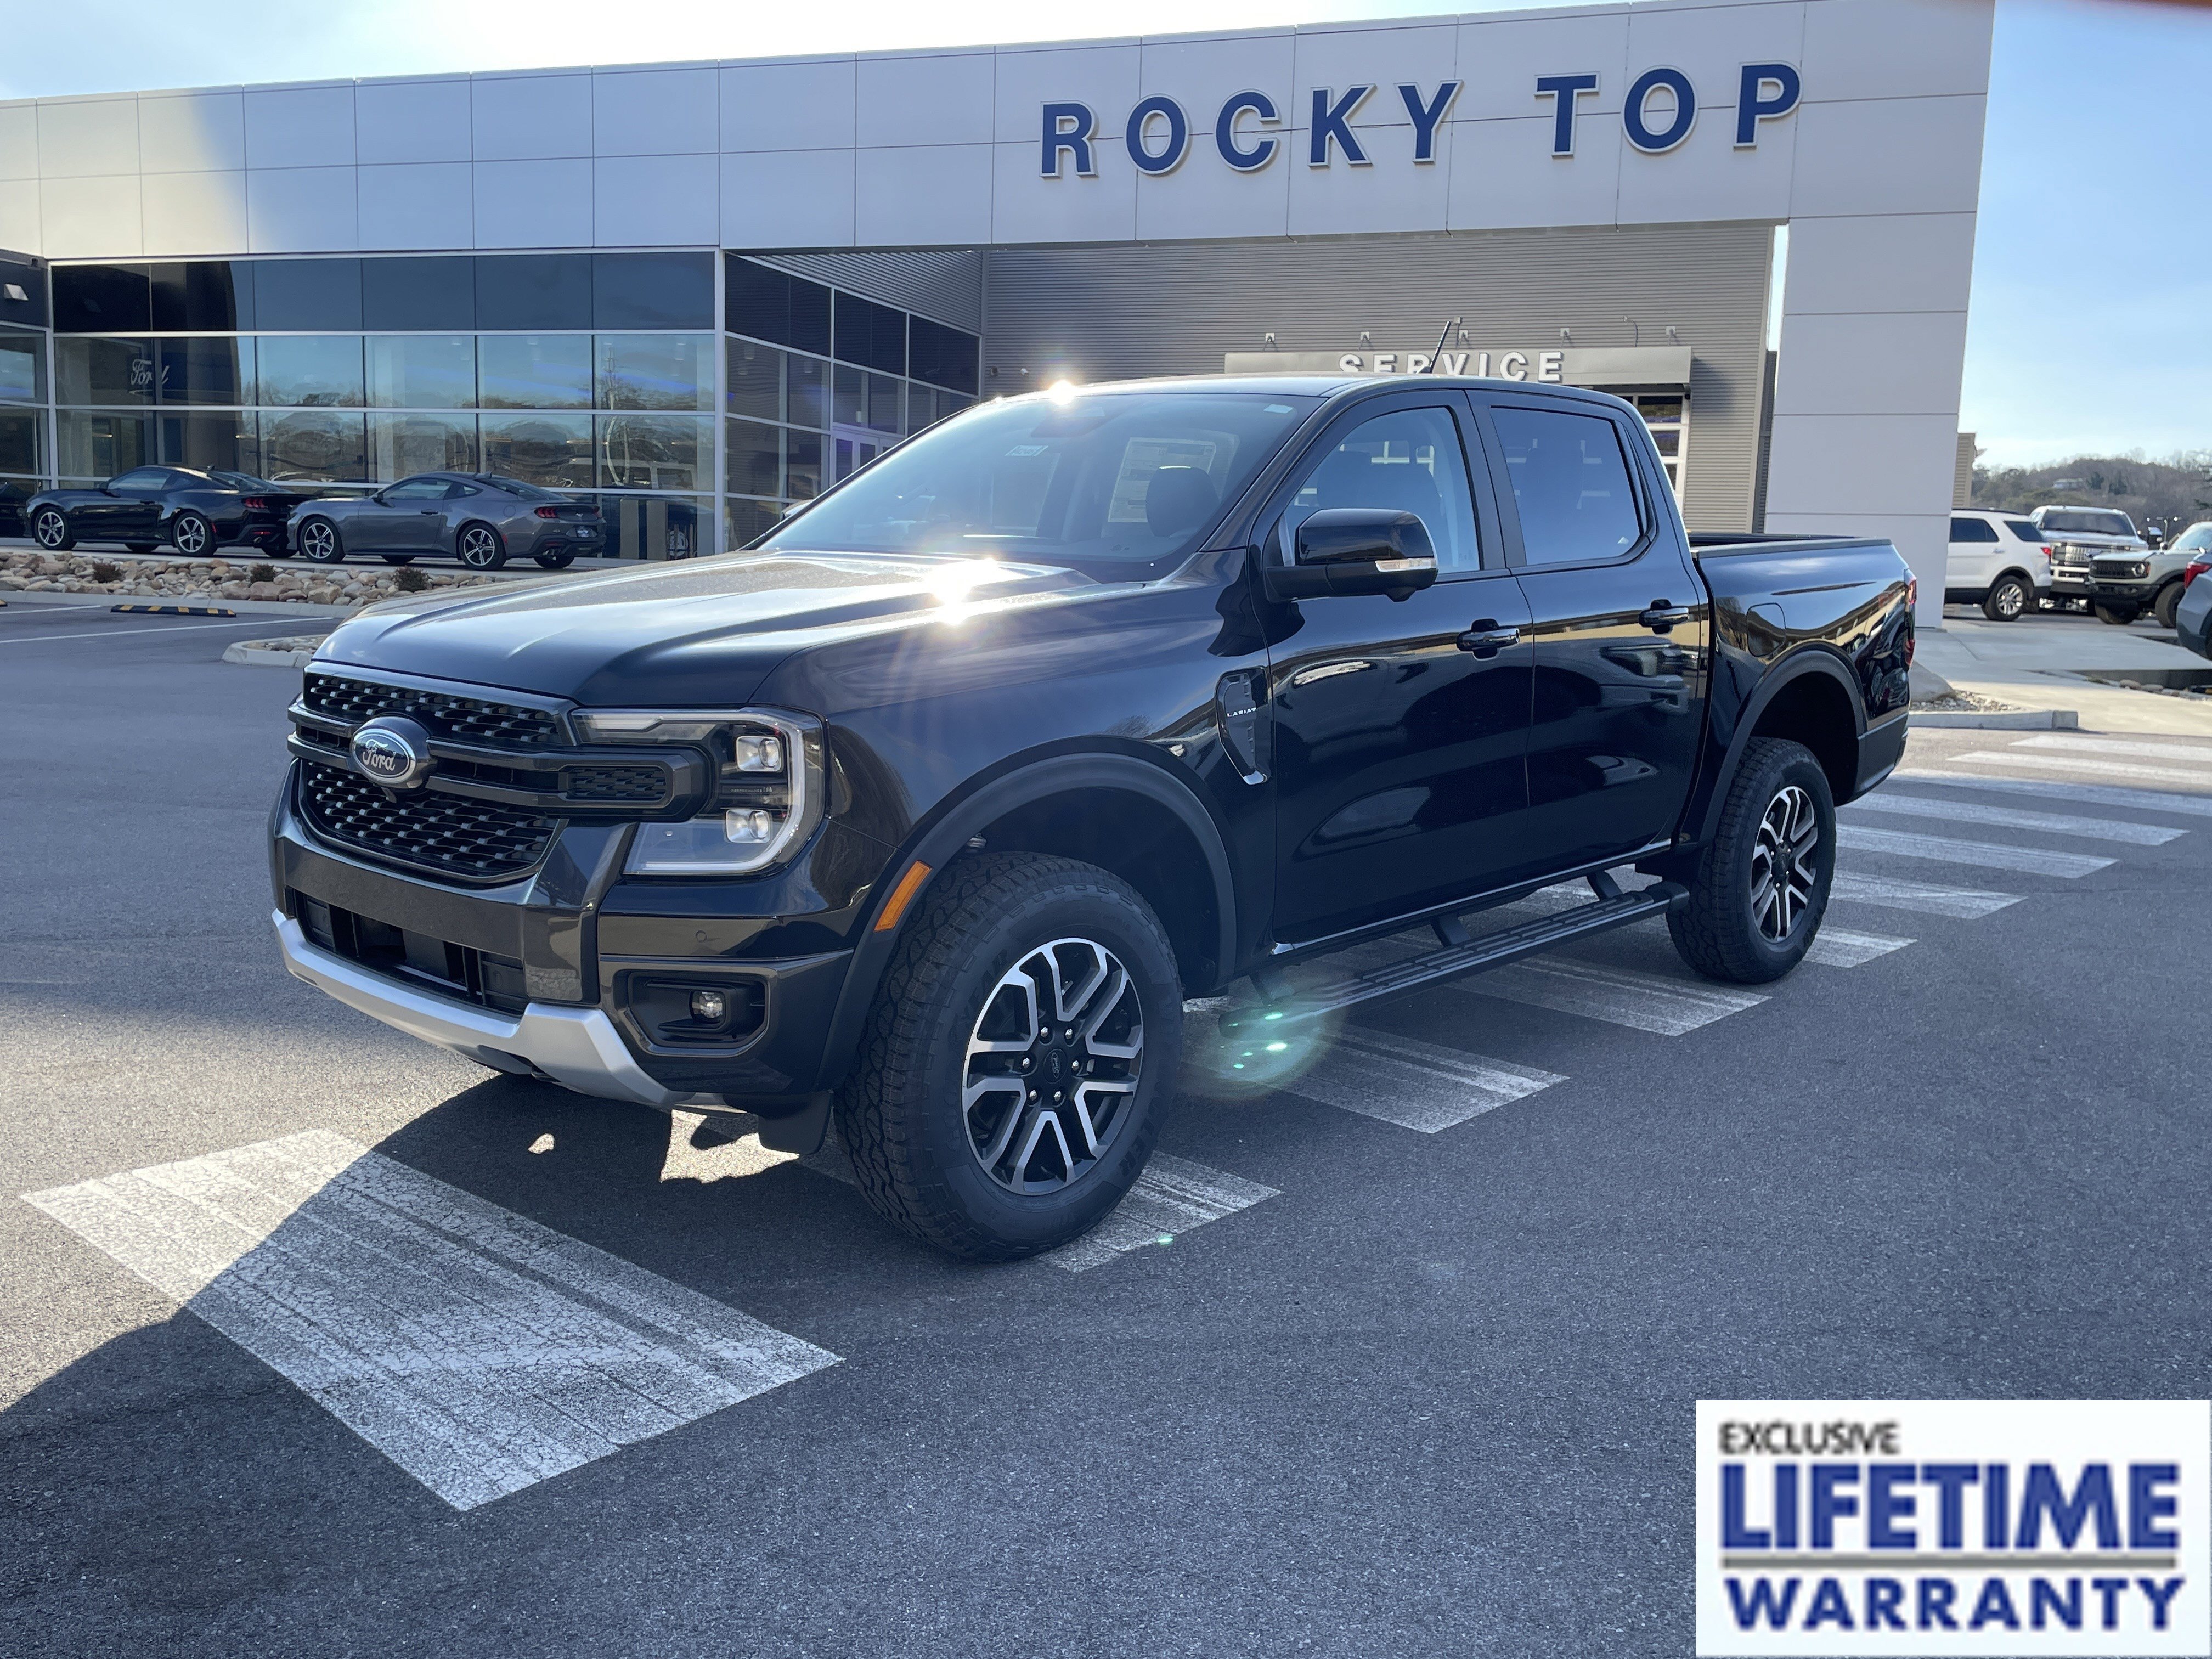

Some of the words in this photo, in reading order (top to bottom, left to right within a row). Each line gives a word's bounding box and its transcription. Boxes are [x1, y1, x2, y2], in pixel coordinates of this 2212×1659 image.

[1040, 79, 1463, 177] ROCKY
[1534, 60, 1802, 157] TOP
[1339, 351, 1562, 382] SERVICE
[362, 738, 396, 771] Ford
